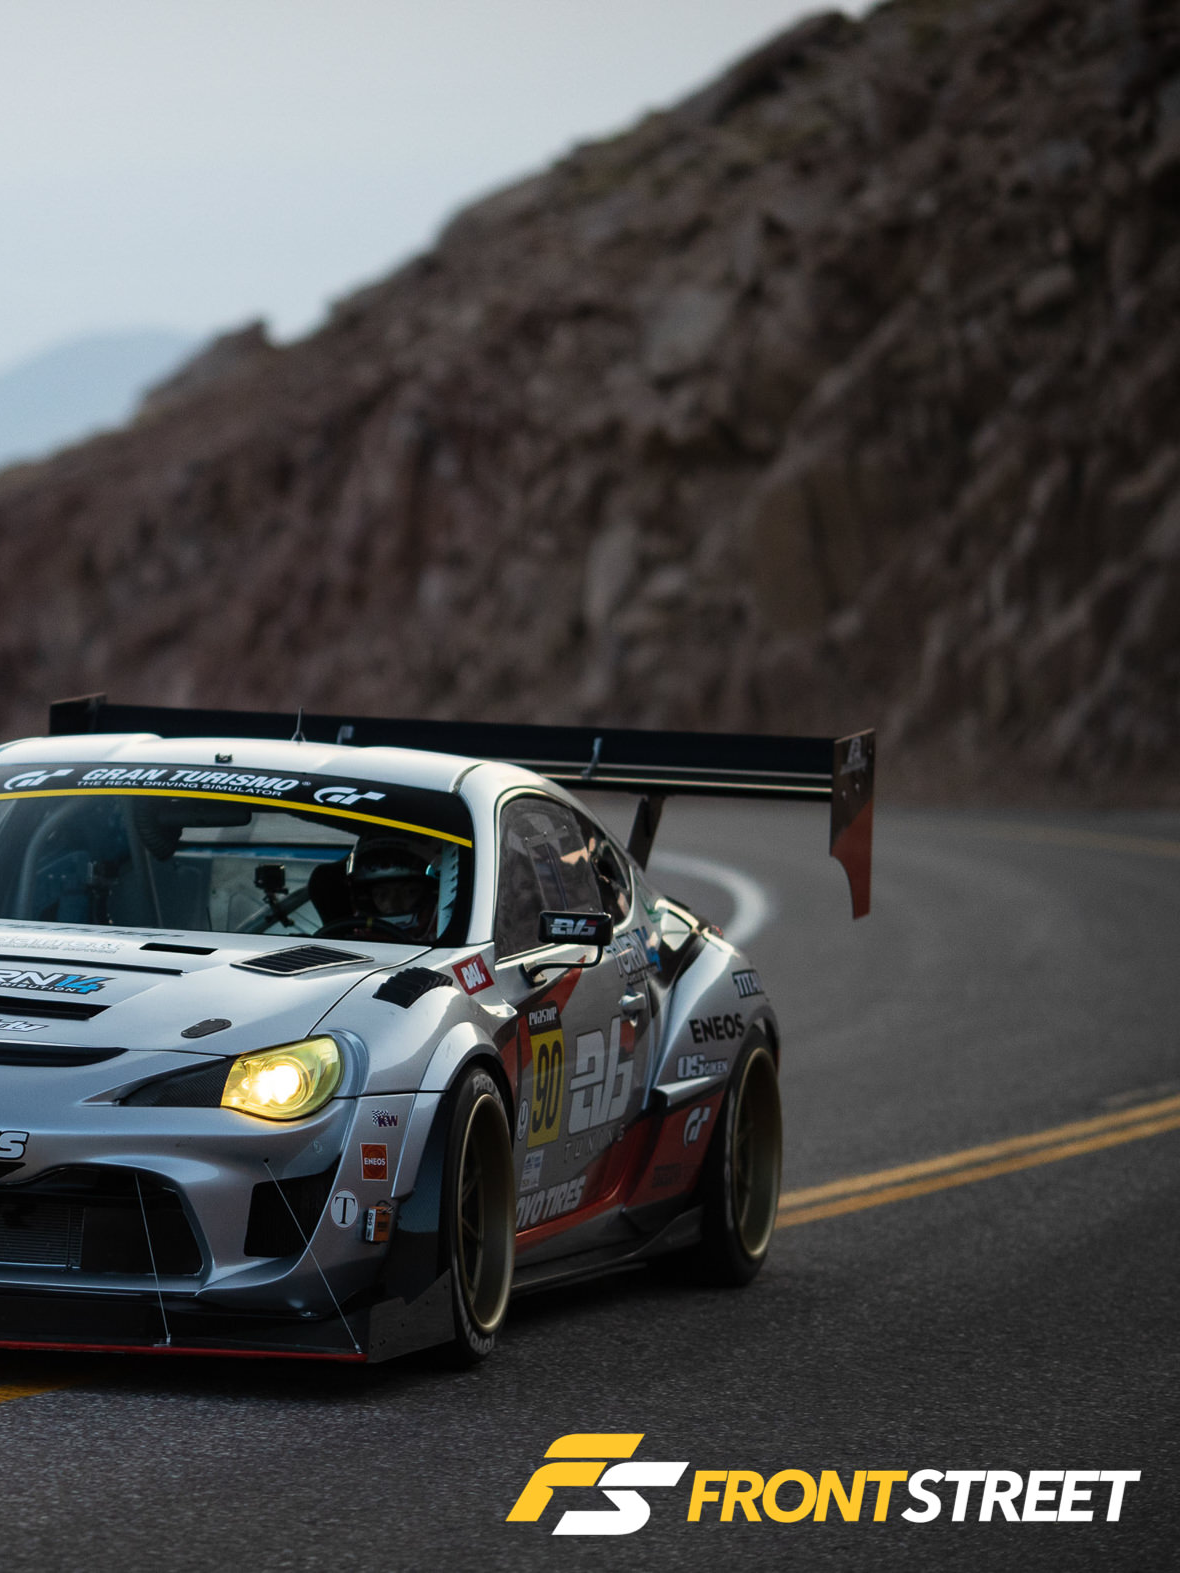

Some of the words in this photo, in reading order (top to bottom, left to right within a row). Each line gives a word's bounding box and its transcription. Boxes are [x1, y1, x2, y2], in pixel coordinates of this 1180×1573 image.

[82, 767, 168, 782] GRAN
[175, 769, 301, 792] TURISMO
[143, 780, 199, 789] DRIVING
[202, 783, 282, 797] SIMULATOR
[689, 1012, 744, 1044] ENEOS
[531, 1039, 562, 1134] 90
[363, 1157, 387, 1166] ENEOS
[334, 1196, 356, 1225] T
[516, 1189, 546, 1229] OYO
[542, 1175, 587, 1221] TIRES
